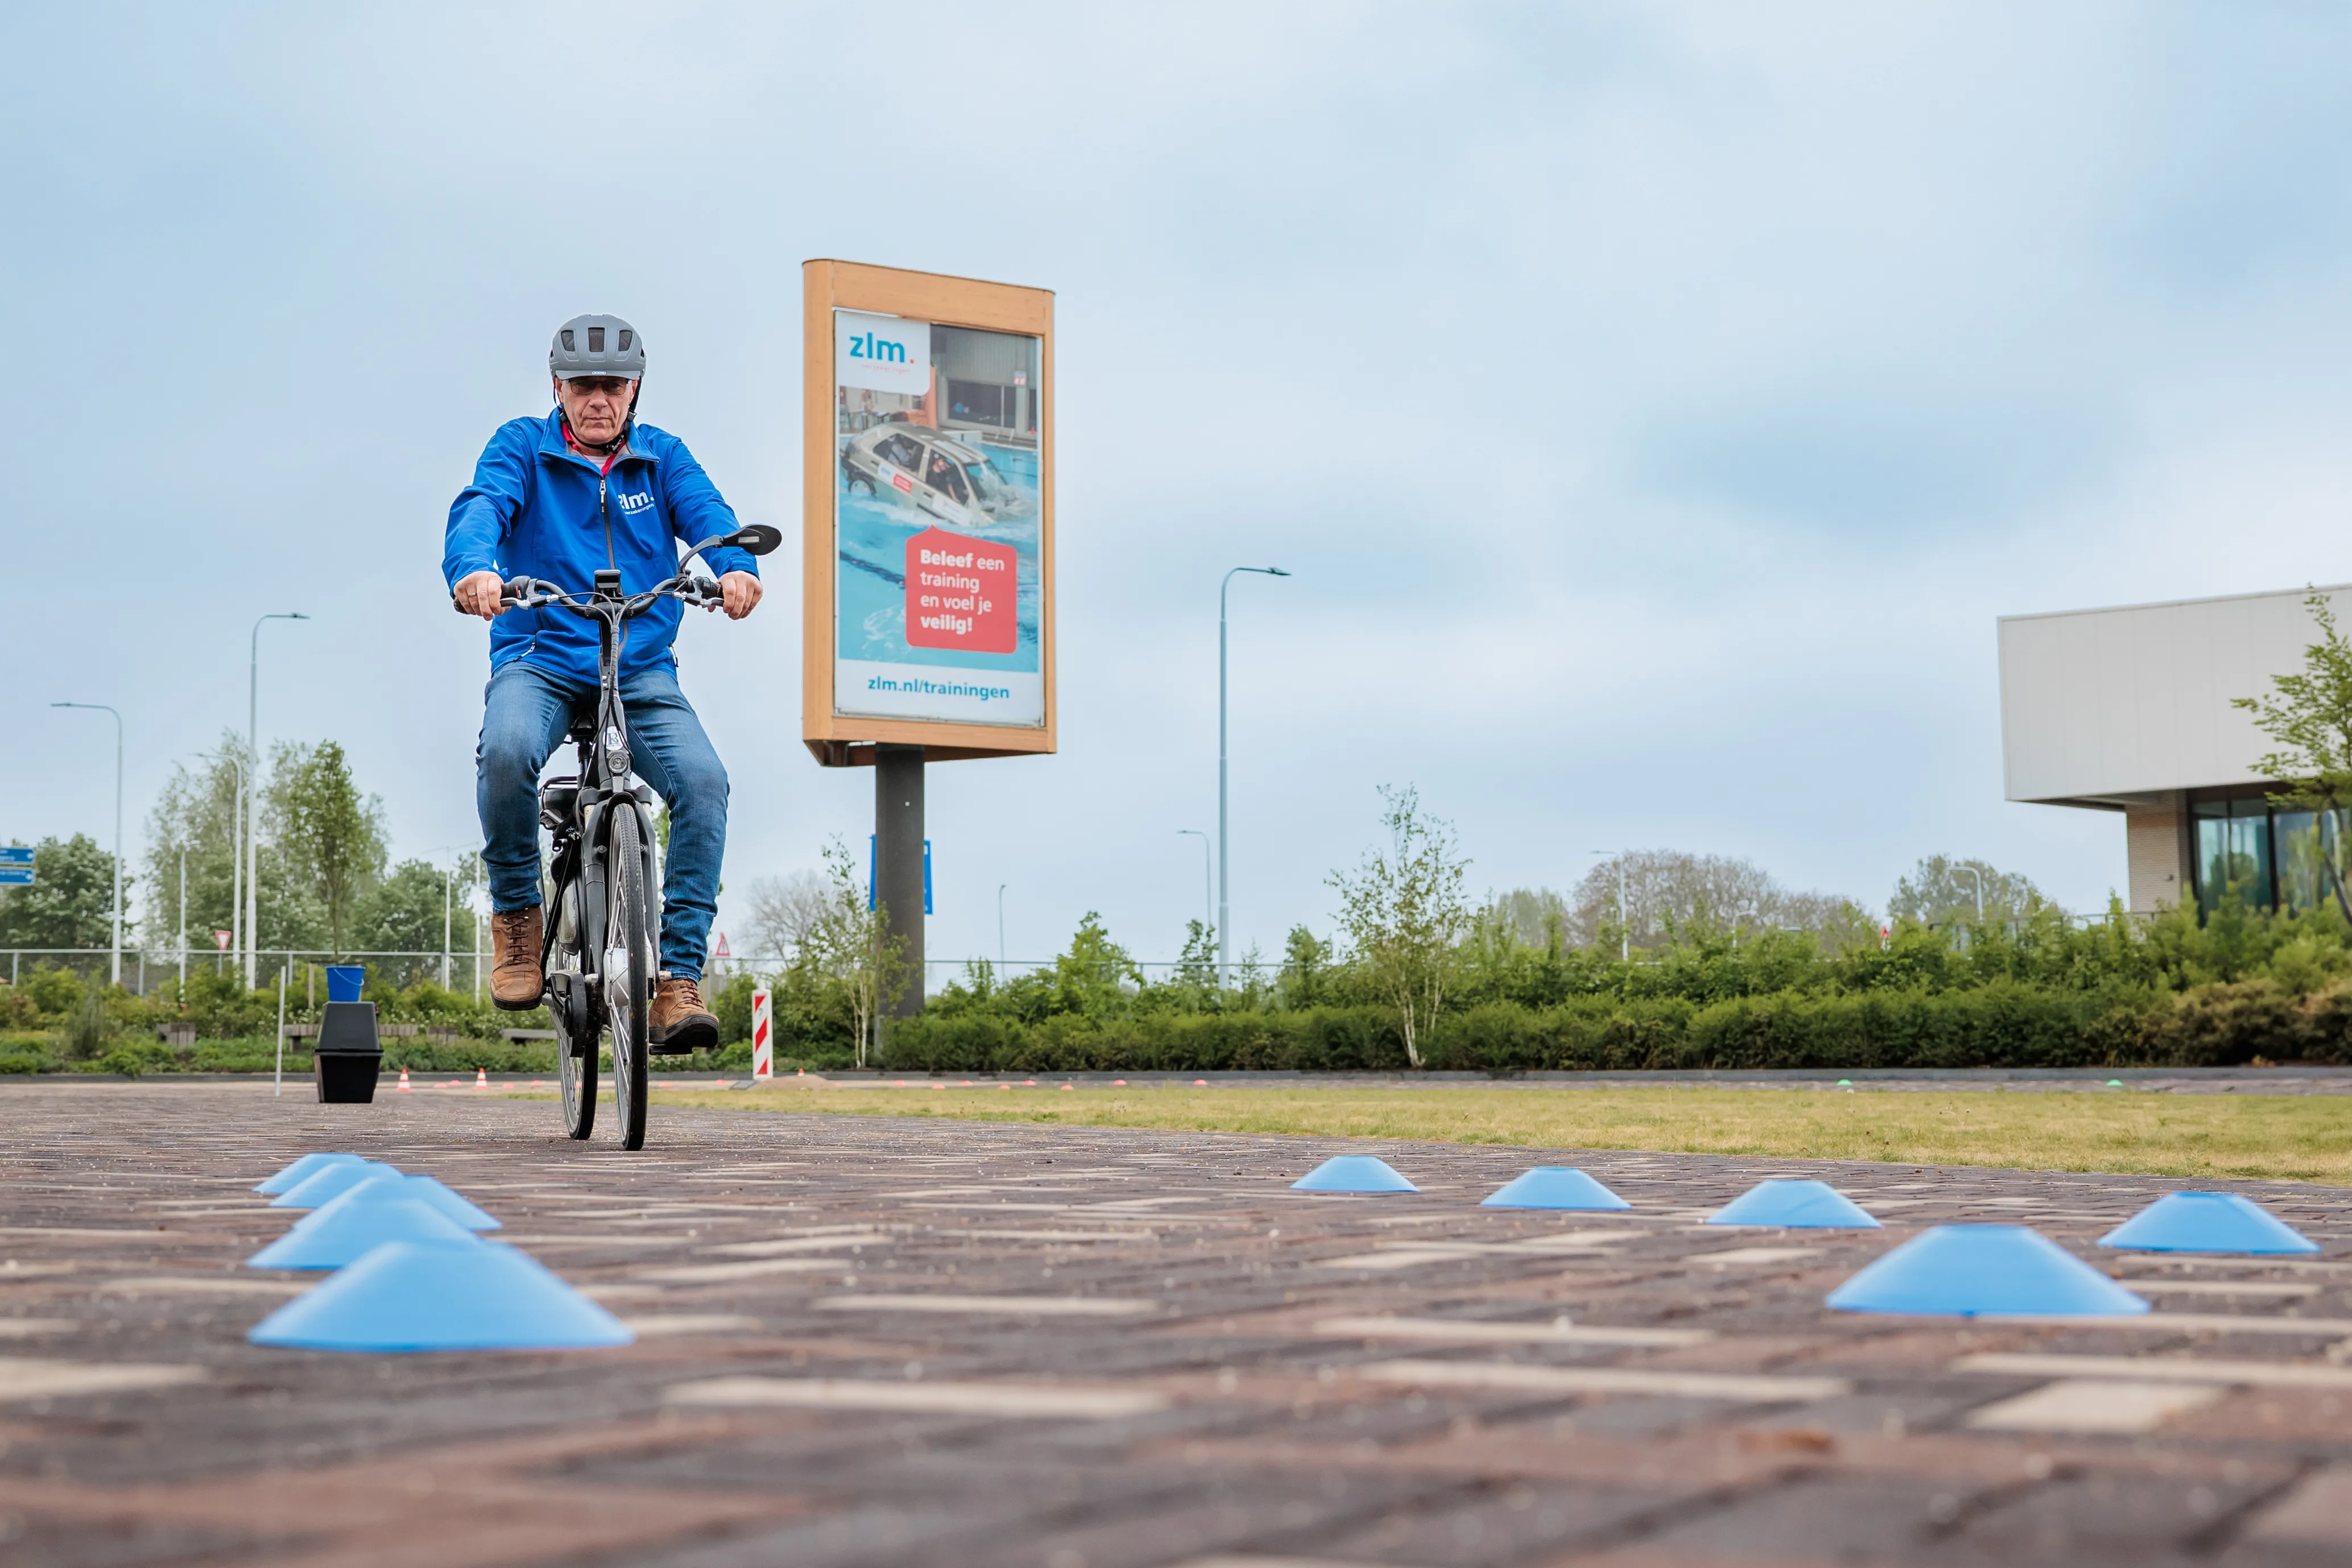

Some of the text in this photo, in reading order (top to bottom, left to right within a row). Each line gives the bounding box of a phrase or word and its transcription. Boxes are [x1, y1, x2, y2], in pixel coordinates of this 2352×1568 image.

[850, 332, 914, 364] zlm.
[920, 549, 1005, 571] Beleef een
[920, 571, 979, 594] training
[920, 595, 992, 615] en voel je
[920, 614, 973, 635] veilig!
[868, 676, 1010, 701] zlm.nl/trainingen
